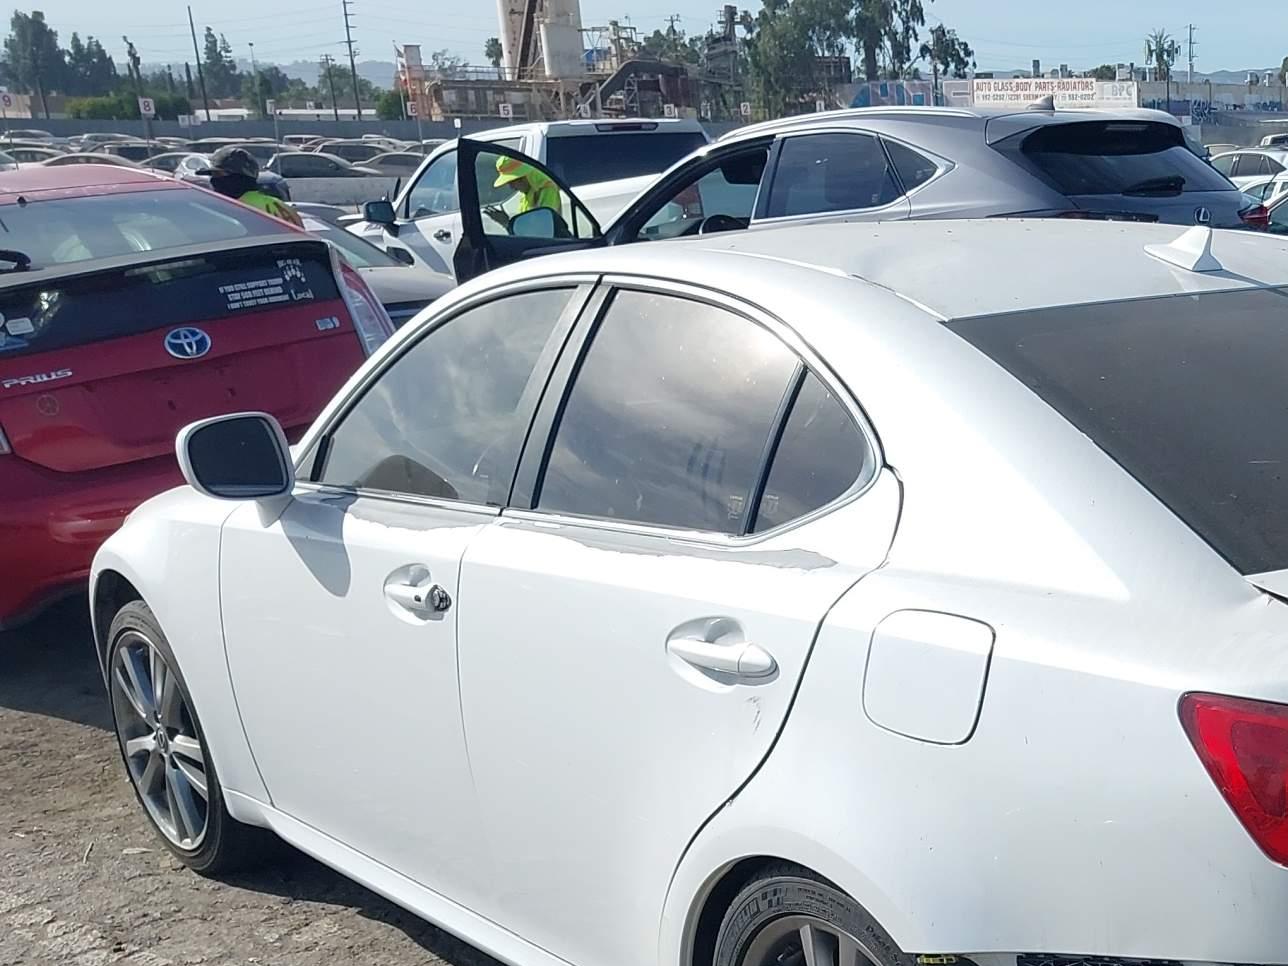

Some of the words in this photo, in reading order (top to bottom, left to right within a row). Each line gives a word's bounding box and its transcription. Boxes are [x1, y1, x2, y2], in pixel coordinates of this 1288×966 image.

[976, 81, 991, 92] AUTO
[3, 95, 11, 107] 9
[143, 101, 151, 111] 8
[502, 105, 510, 116] 5
[666, 106, 674, 116] 3
[742, 104, 749, 114] 2
[1, 368, 73, 388] PRIUS
